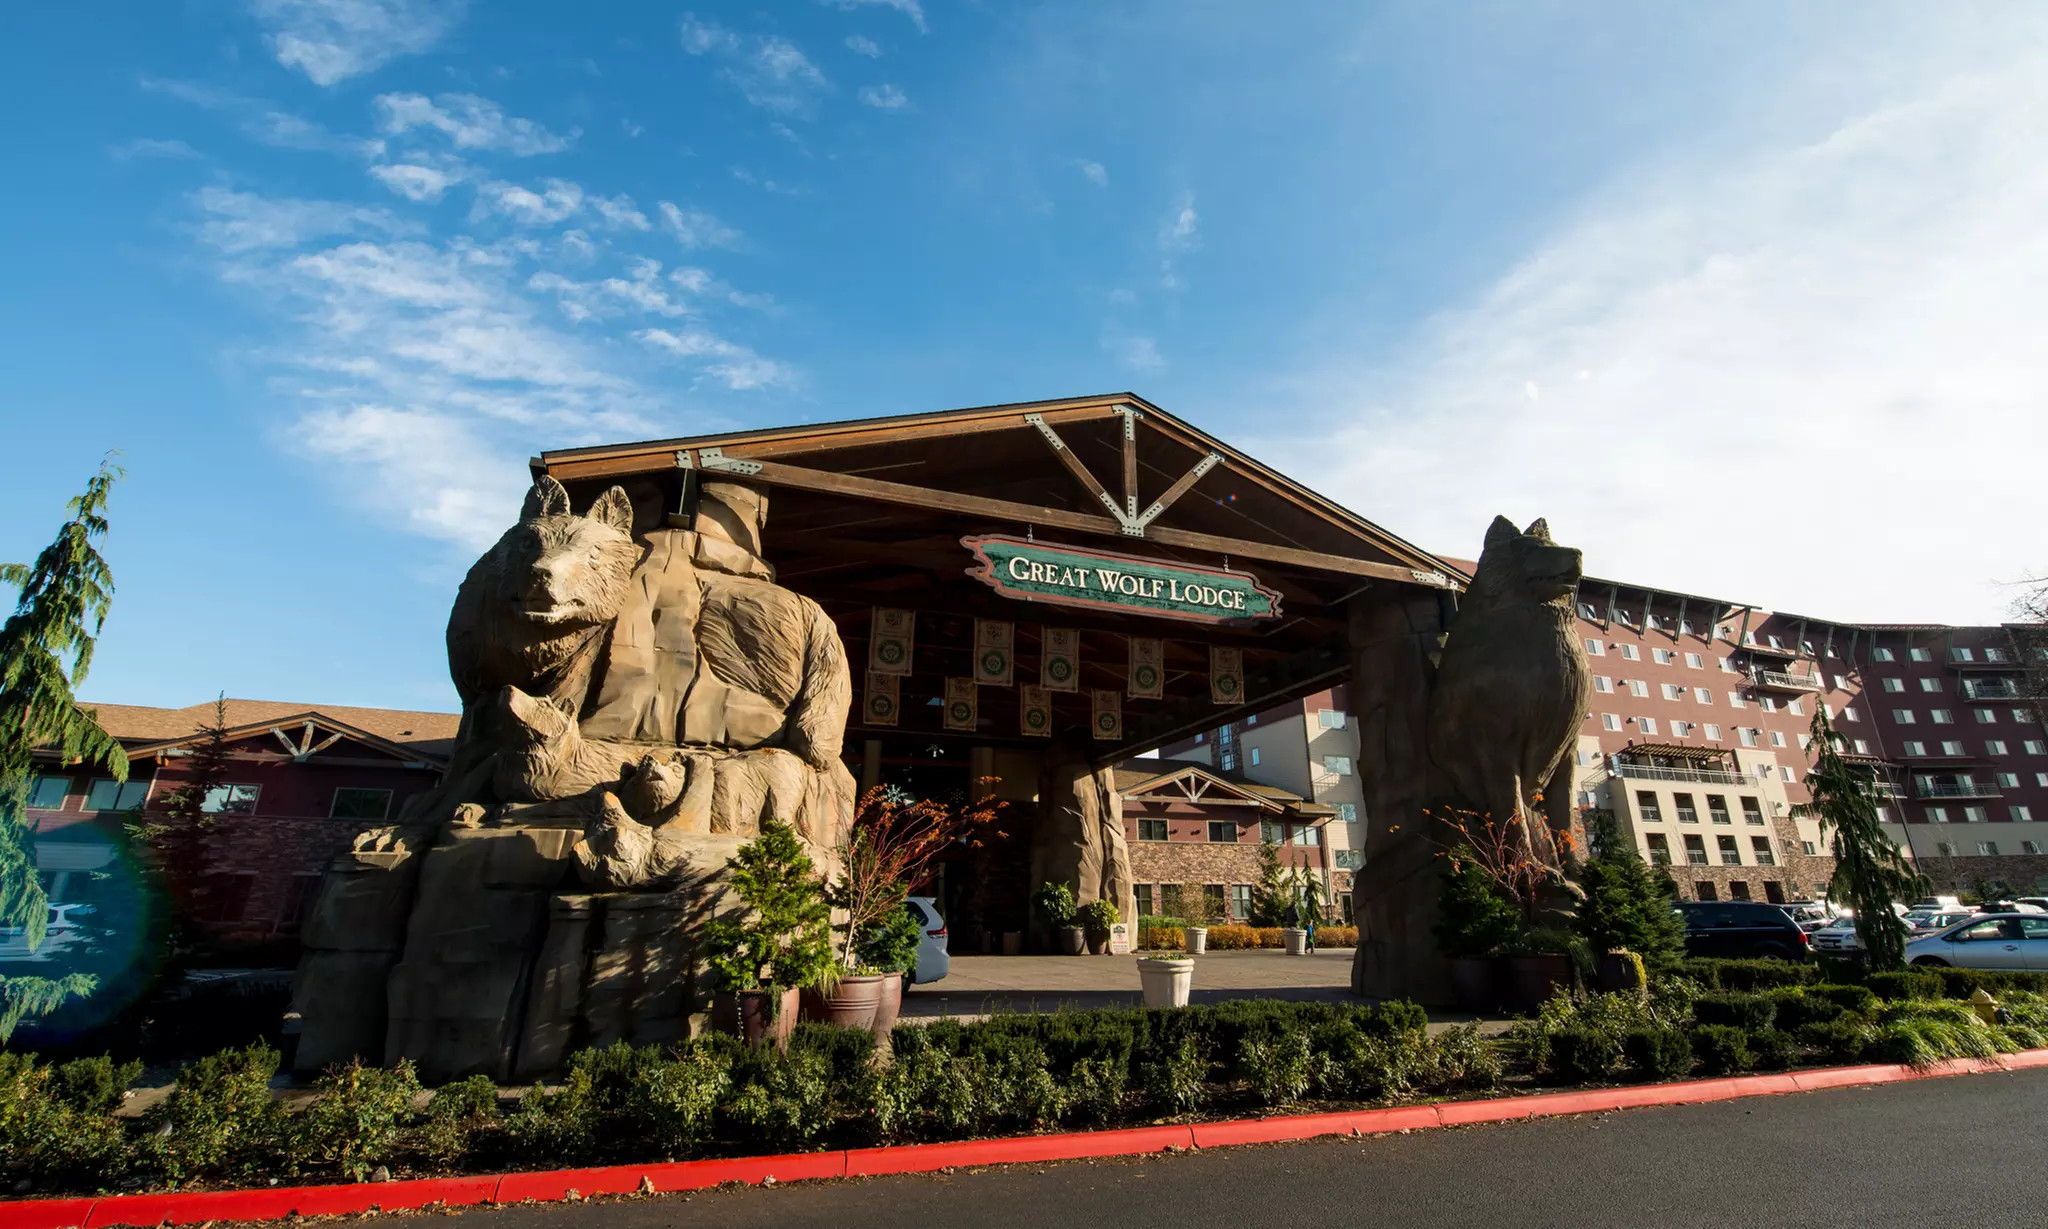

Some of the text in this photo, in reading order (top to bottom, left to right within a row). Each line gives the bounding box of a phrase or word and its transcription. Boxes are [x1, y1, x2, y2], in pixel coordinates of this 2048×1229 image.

[1008, 556, 1246, 610] GREAT WOLF LODGE
